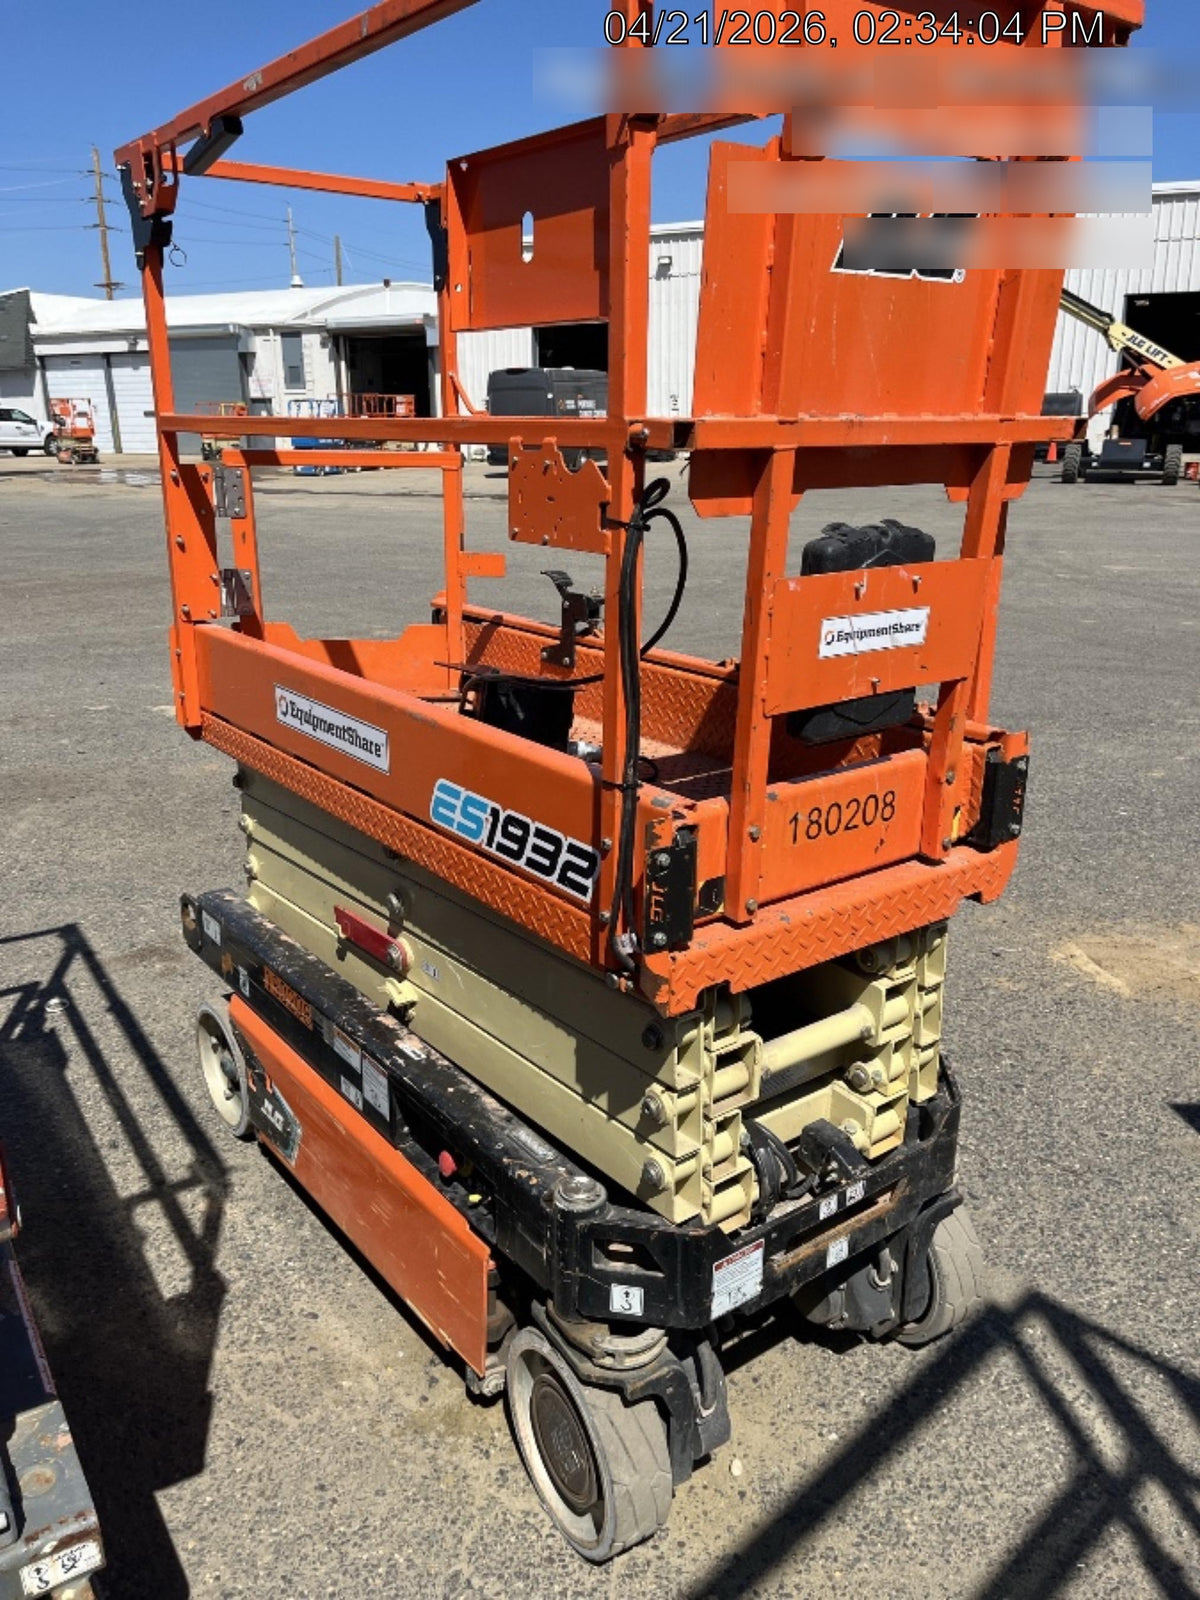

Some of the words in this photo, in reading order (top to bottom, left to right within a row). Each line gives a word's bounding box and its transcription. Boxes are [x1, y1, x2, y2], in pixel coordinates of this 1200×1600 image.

[1145, 344, 1168, 361] LIFT
[836, 622, 921, 643] EquipmentShare
[289, 700, 382, 758] EquipmentShare
[431, 781, 600, 899] ES1932
[789, 790, 896, 845] 180208
